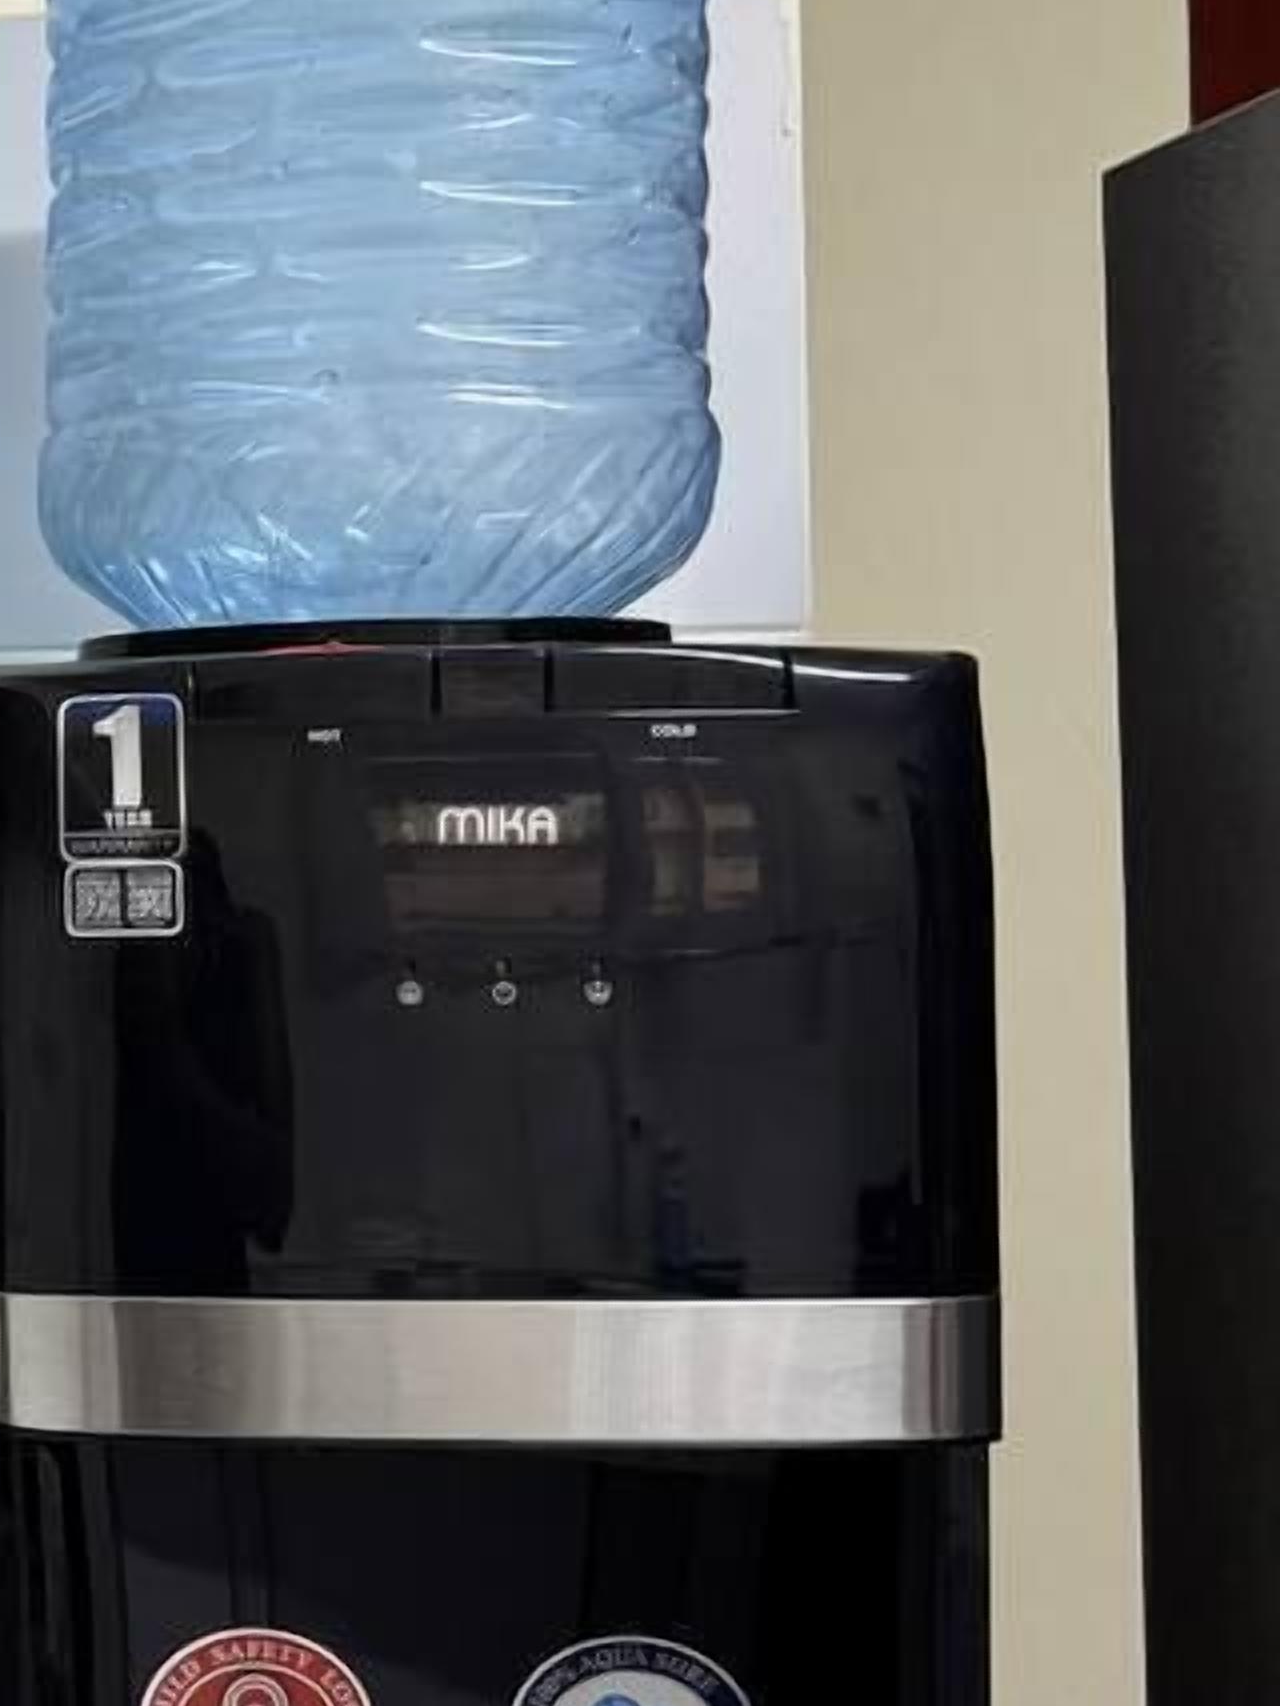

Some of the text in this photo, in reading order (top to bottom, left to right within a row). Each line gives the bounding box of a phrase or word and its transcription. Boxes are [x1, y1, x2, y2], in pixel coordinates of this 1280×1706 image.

[92, 704, 142, 808] 1
[439, 806, 559, 845] MIKA
[209, 1640, 313, 1667] SAFETY
